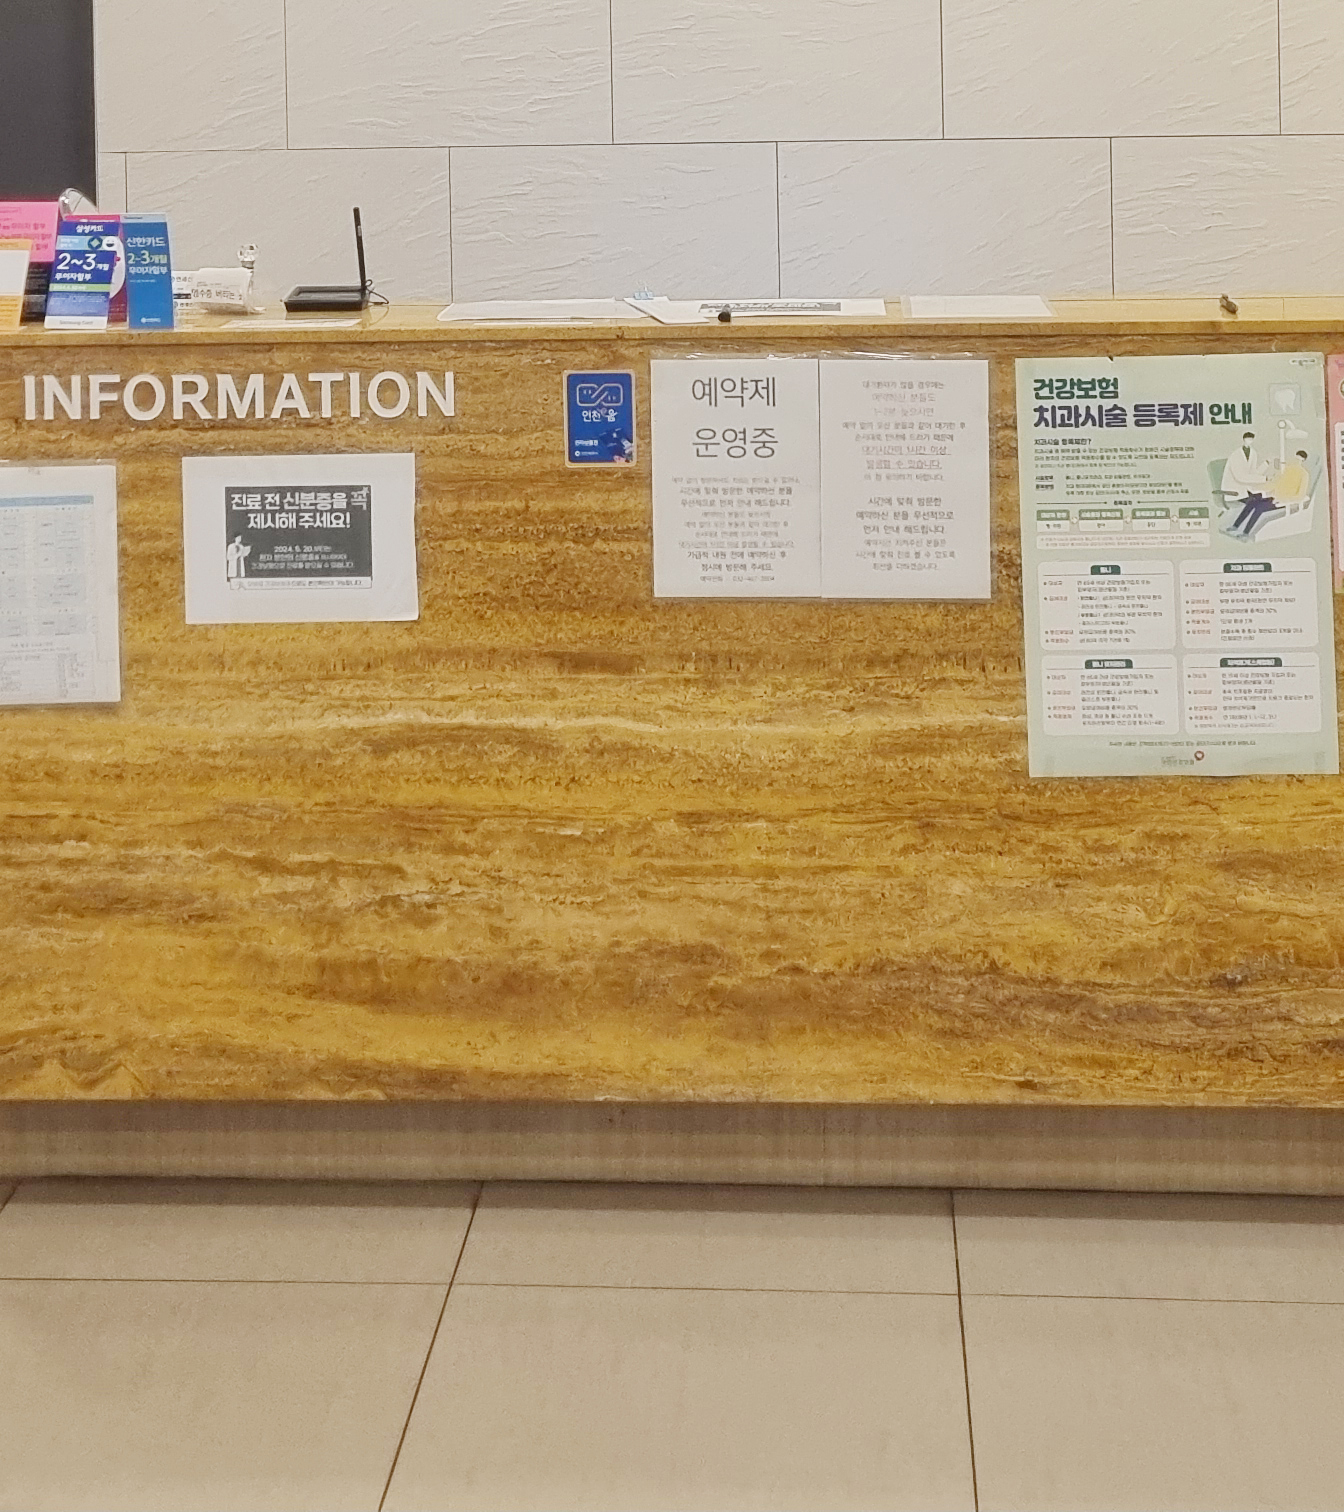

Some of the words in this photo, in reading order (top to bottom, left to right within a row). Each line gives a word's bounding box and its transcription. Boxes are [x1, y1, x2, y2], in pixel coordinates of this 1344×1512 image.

[126, 236, 166, 248] 신한카드
[55, 272, 92, 282] 무이자할부
[24, 371, 456, 421] INFORMATION
[692, 376, 776, 408] 예약제
[1033, 377, 1119, 400] 건강보험
[1033, 403, 1128, 429] 치과시술
[1132, 402, 1204, 427] 등록제
[1208, 402, 1253, 425] 안내
[692, 427, 779, 458] 운영중
[231, 494, 262, 509] 진료
[264, 494, 281, 509] 전
[283, 492, 347, 510] 신분증을
[247, 513, 297, 529] 제시해
[298, 512, 351, 529] 주세요!
